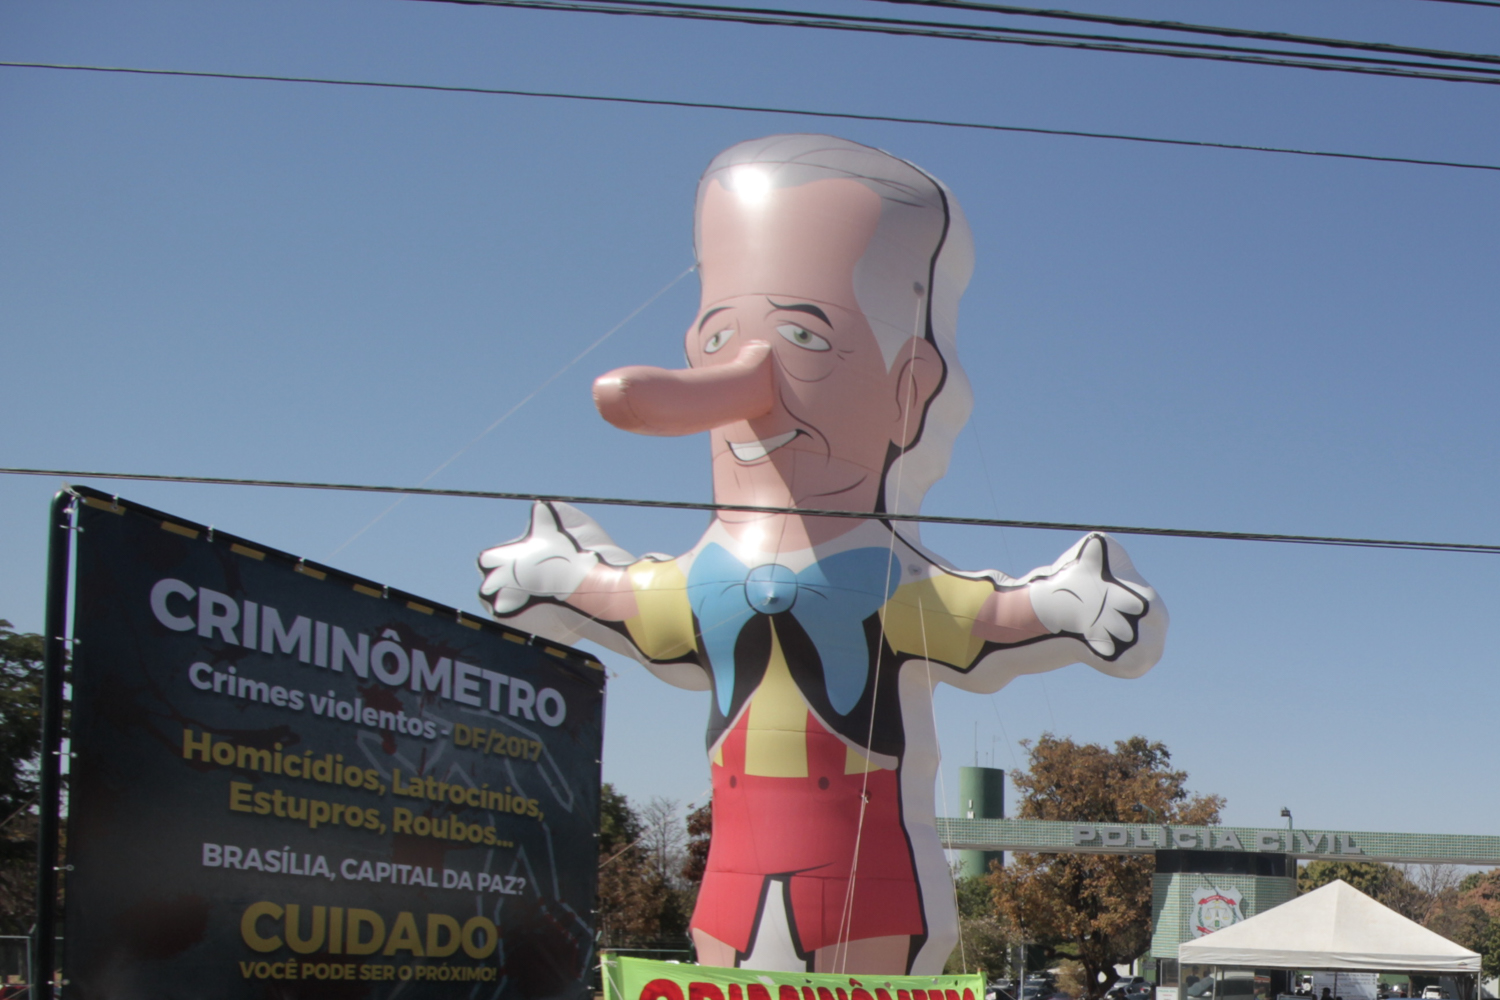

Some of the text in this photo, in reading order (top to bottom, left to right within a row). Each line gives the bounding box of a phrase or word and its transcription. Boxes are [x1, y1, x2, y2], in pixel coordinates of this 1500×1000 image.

[150, 578, 567, 727] CRIMINÔMETRO
[189, 661, 304, 710] Crimes
[310, 690, 436, 739] violentos
[454, 723, 543, 761] DF/2017
[183, 729, 545, 821] Homicídios, Latrocínios,
[229, 781, 514, 848] Estupros, Roubos...
[1257, 830, 1361, 853] CIVIL
[202, 843, 526, 896] BRASÍLIA, CAPITAL DA PAZ?
[240, 901, 498, 960] CUIDADO
[240, 958, 497, 982] VOCÊ PODE SER O PRÓXIMO!
